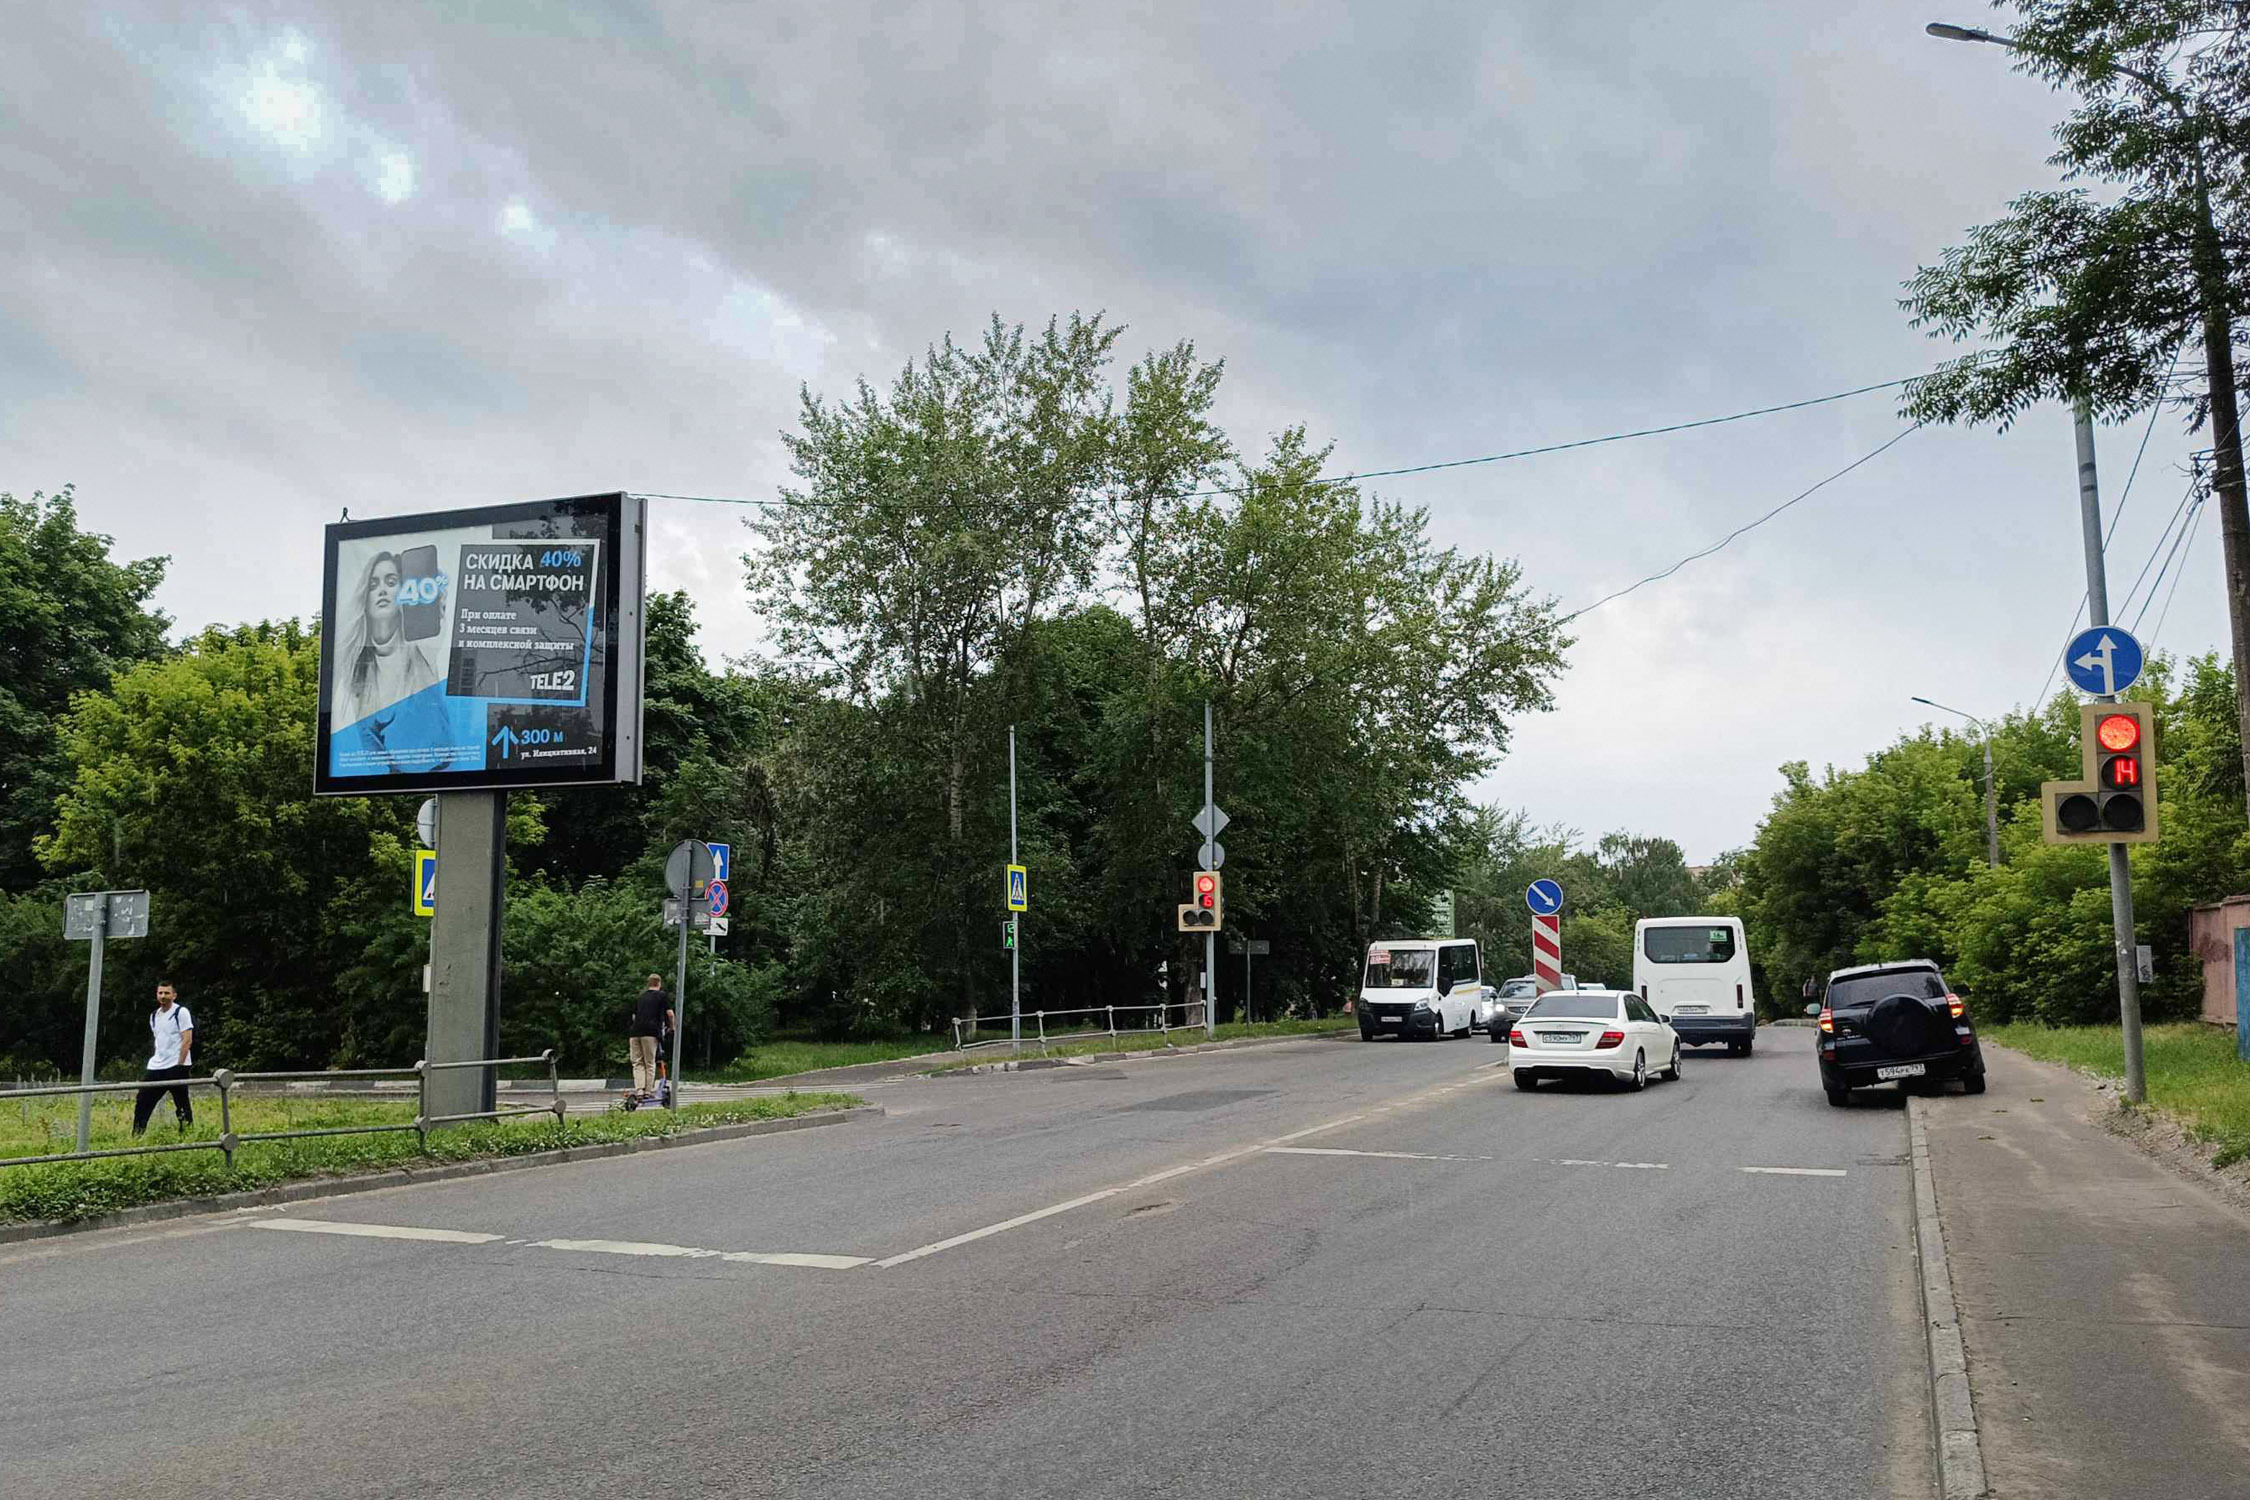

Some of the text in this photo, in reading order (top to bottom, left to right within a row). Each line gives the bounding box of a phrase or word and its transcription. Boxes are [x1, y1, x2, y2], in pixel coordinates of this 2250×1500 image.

[466, 551, 581, 573] СКИДКА 40%
[464, 574, 584, 591] НА СМАРТФОН
[460, 608, 517, 622] При оплате
[459, 623, 538, 635] 3 месяцев связи
[458, 639, 574, 651] и комплексной защиты
[530, 669, 576, 691] TELE2
[521, 728, 550, 745] 300
[520, 750, 532, 760] ул.
[588, 746, 597, 754] 24
